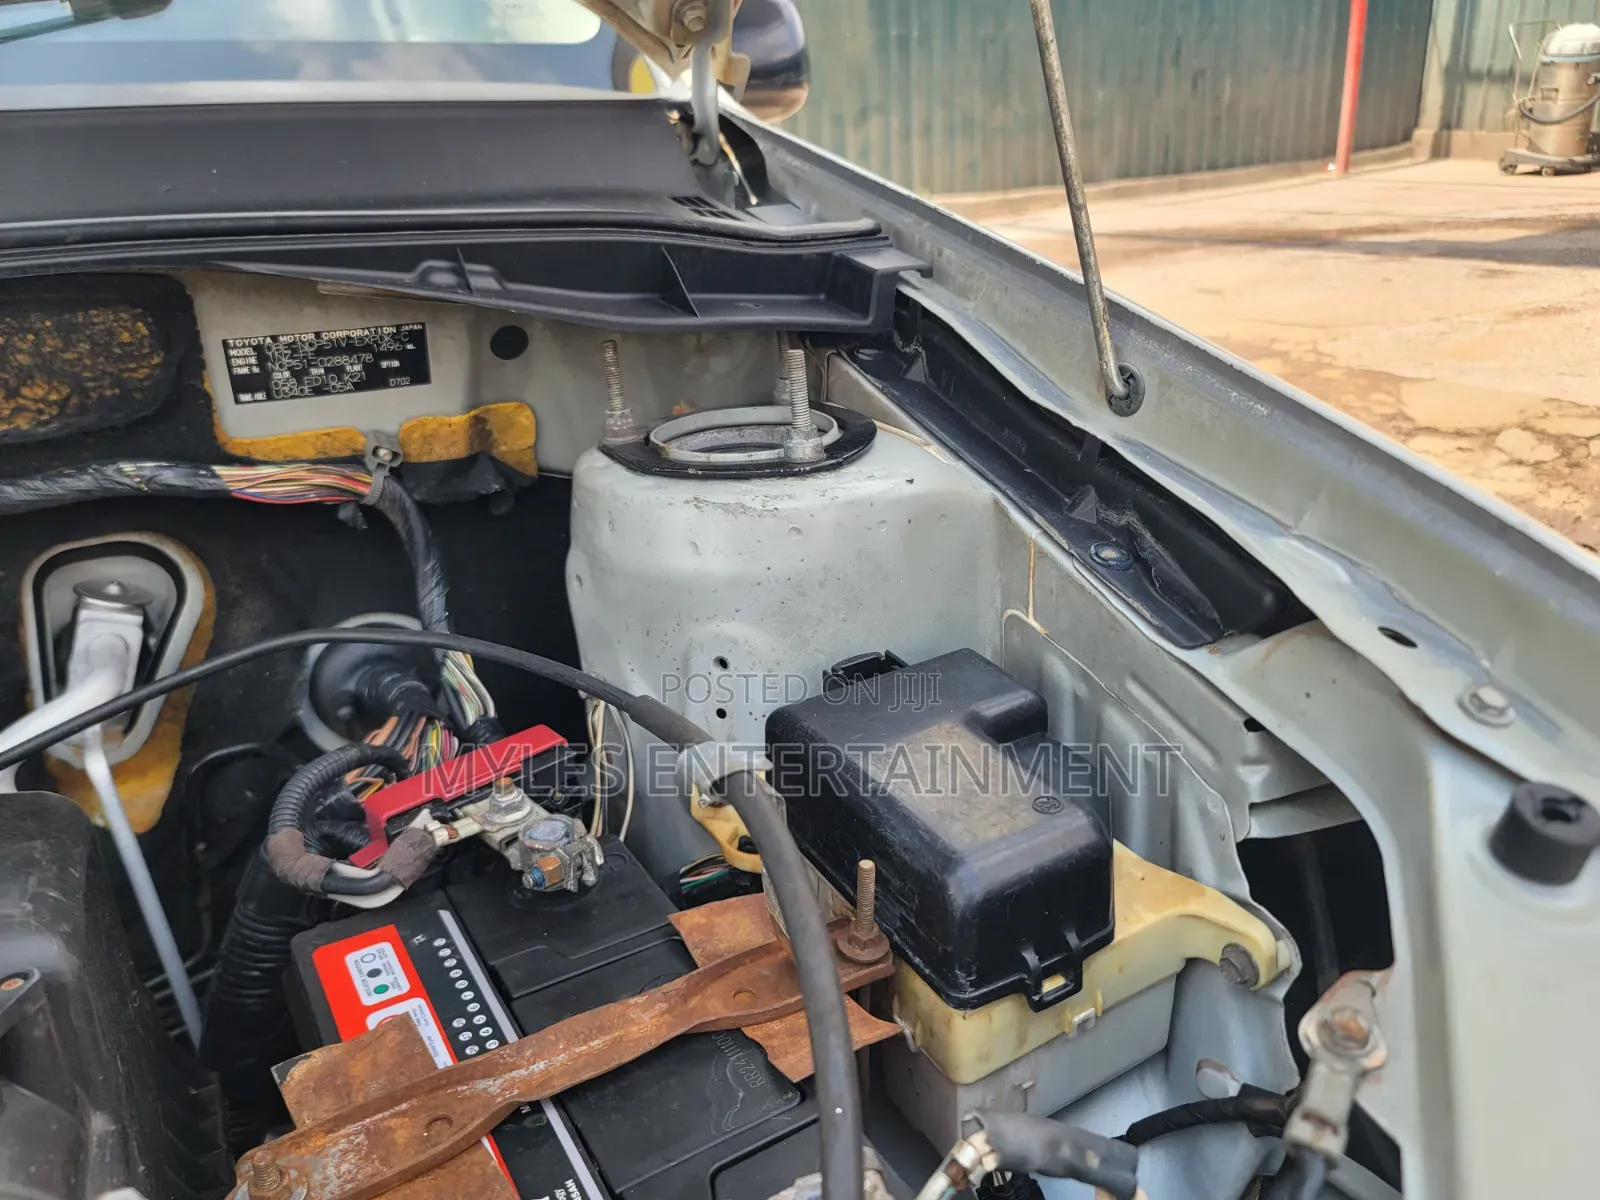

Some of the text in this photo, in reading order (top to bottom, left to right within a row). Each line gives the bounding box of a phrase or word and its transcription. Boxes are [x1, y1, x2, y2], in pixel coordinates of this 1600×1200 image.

[227, 323, 423, 348] TOYOTA MOTOR CORPORATION JAPAN
[229, 346, 258, 357] MODEL
[231, 356, 259, 366] ENGINE
[372, 342, 404, 353] 1496
[267, 353, 375, 372] NCP51-0288478
[272, 371, 291, 380] COLOR
[380, 360, 401, 369] OPTION
[344, 371, 367, 383] K21
[389, 376, 411, 387] D702
